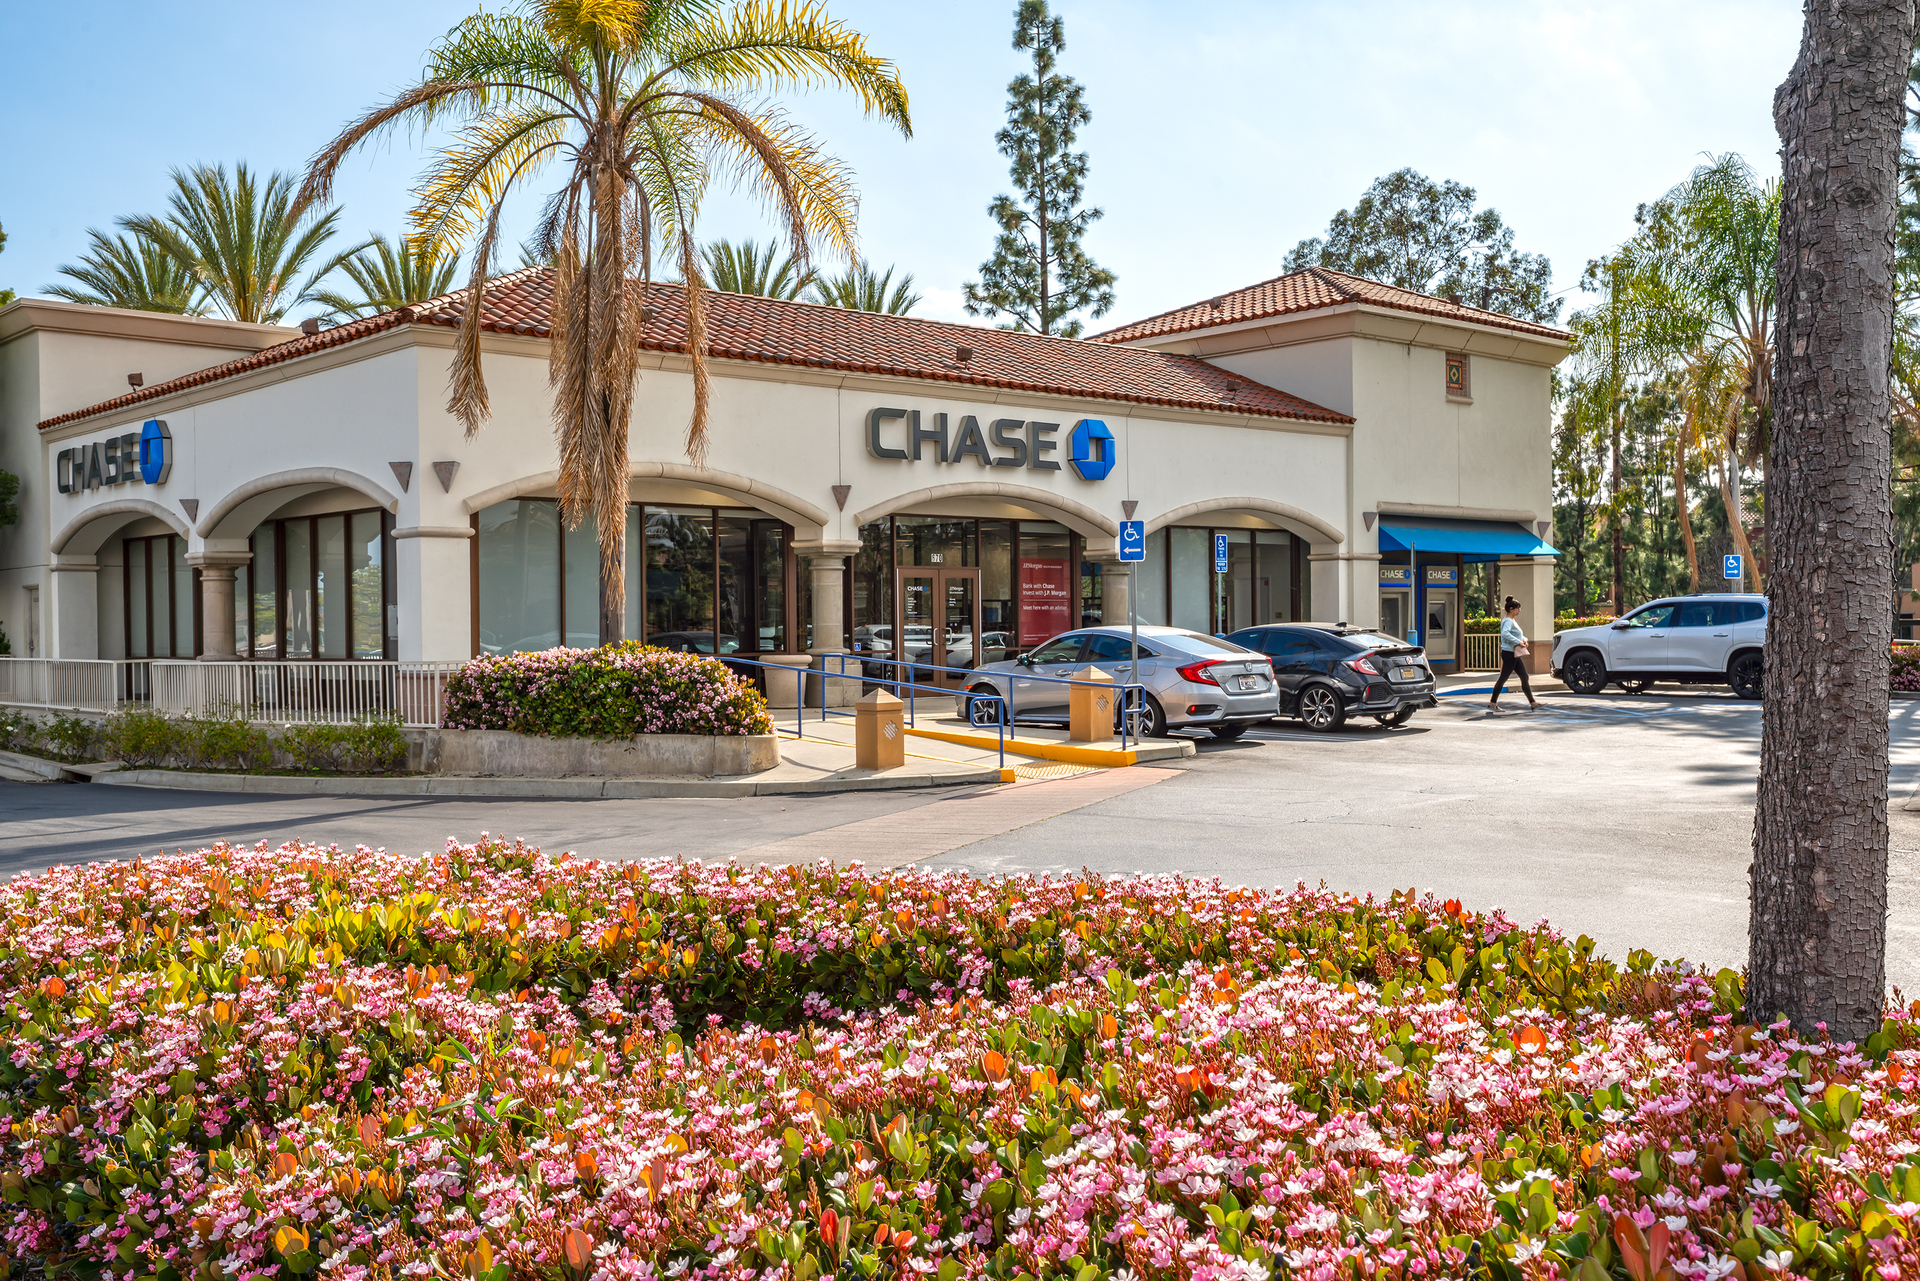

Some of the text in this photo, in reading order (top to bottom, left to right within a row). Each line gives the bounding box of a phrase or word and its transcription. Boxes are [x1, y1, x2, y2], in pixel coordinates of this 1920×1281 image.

[865, 407, 1062, 471] CHASE
[57, 432, 143, 494] CHASE
[1380, 569, 1404, 579] CHASE
[1428, 570, 1451, 579] CHASE
